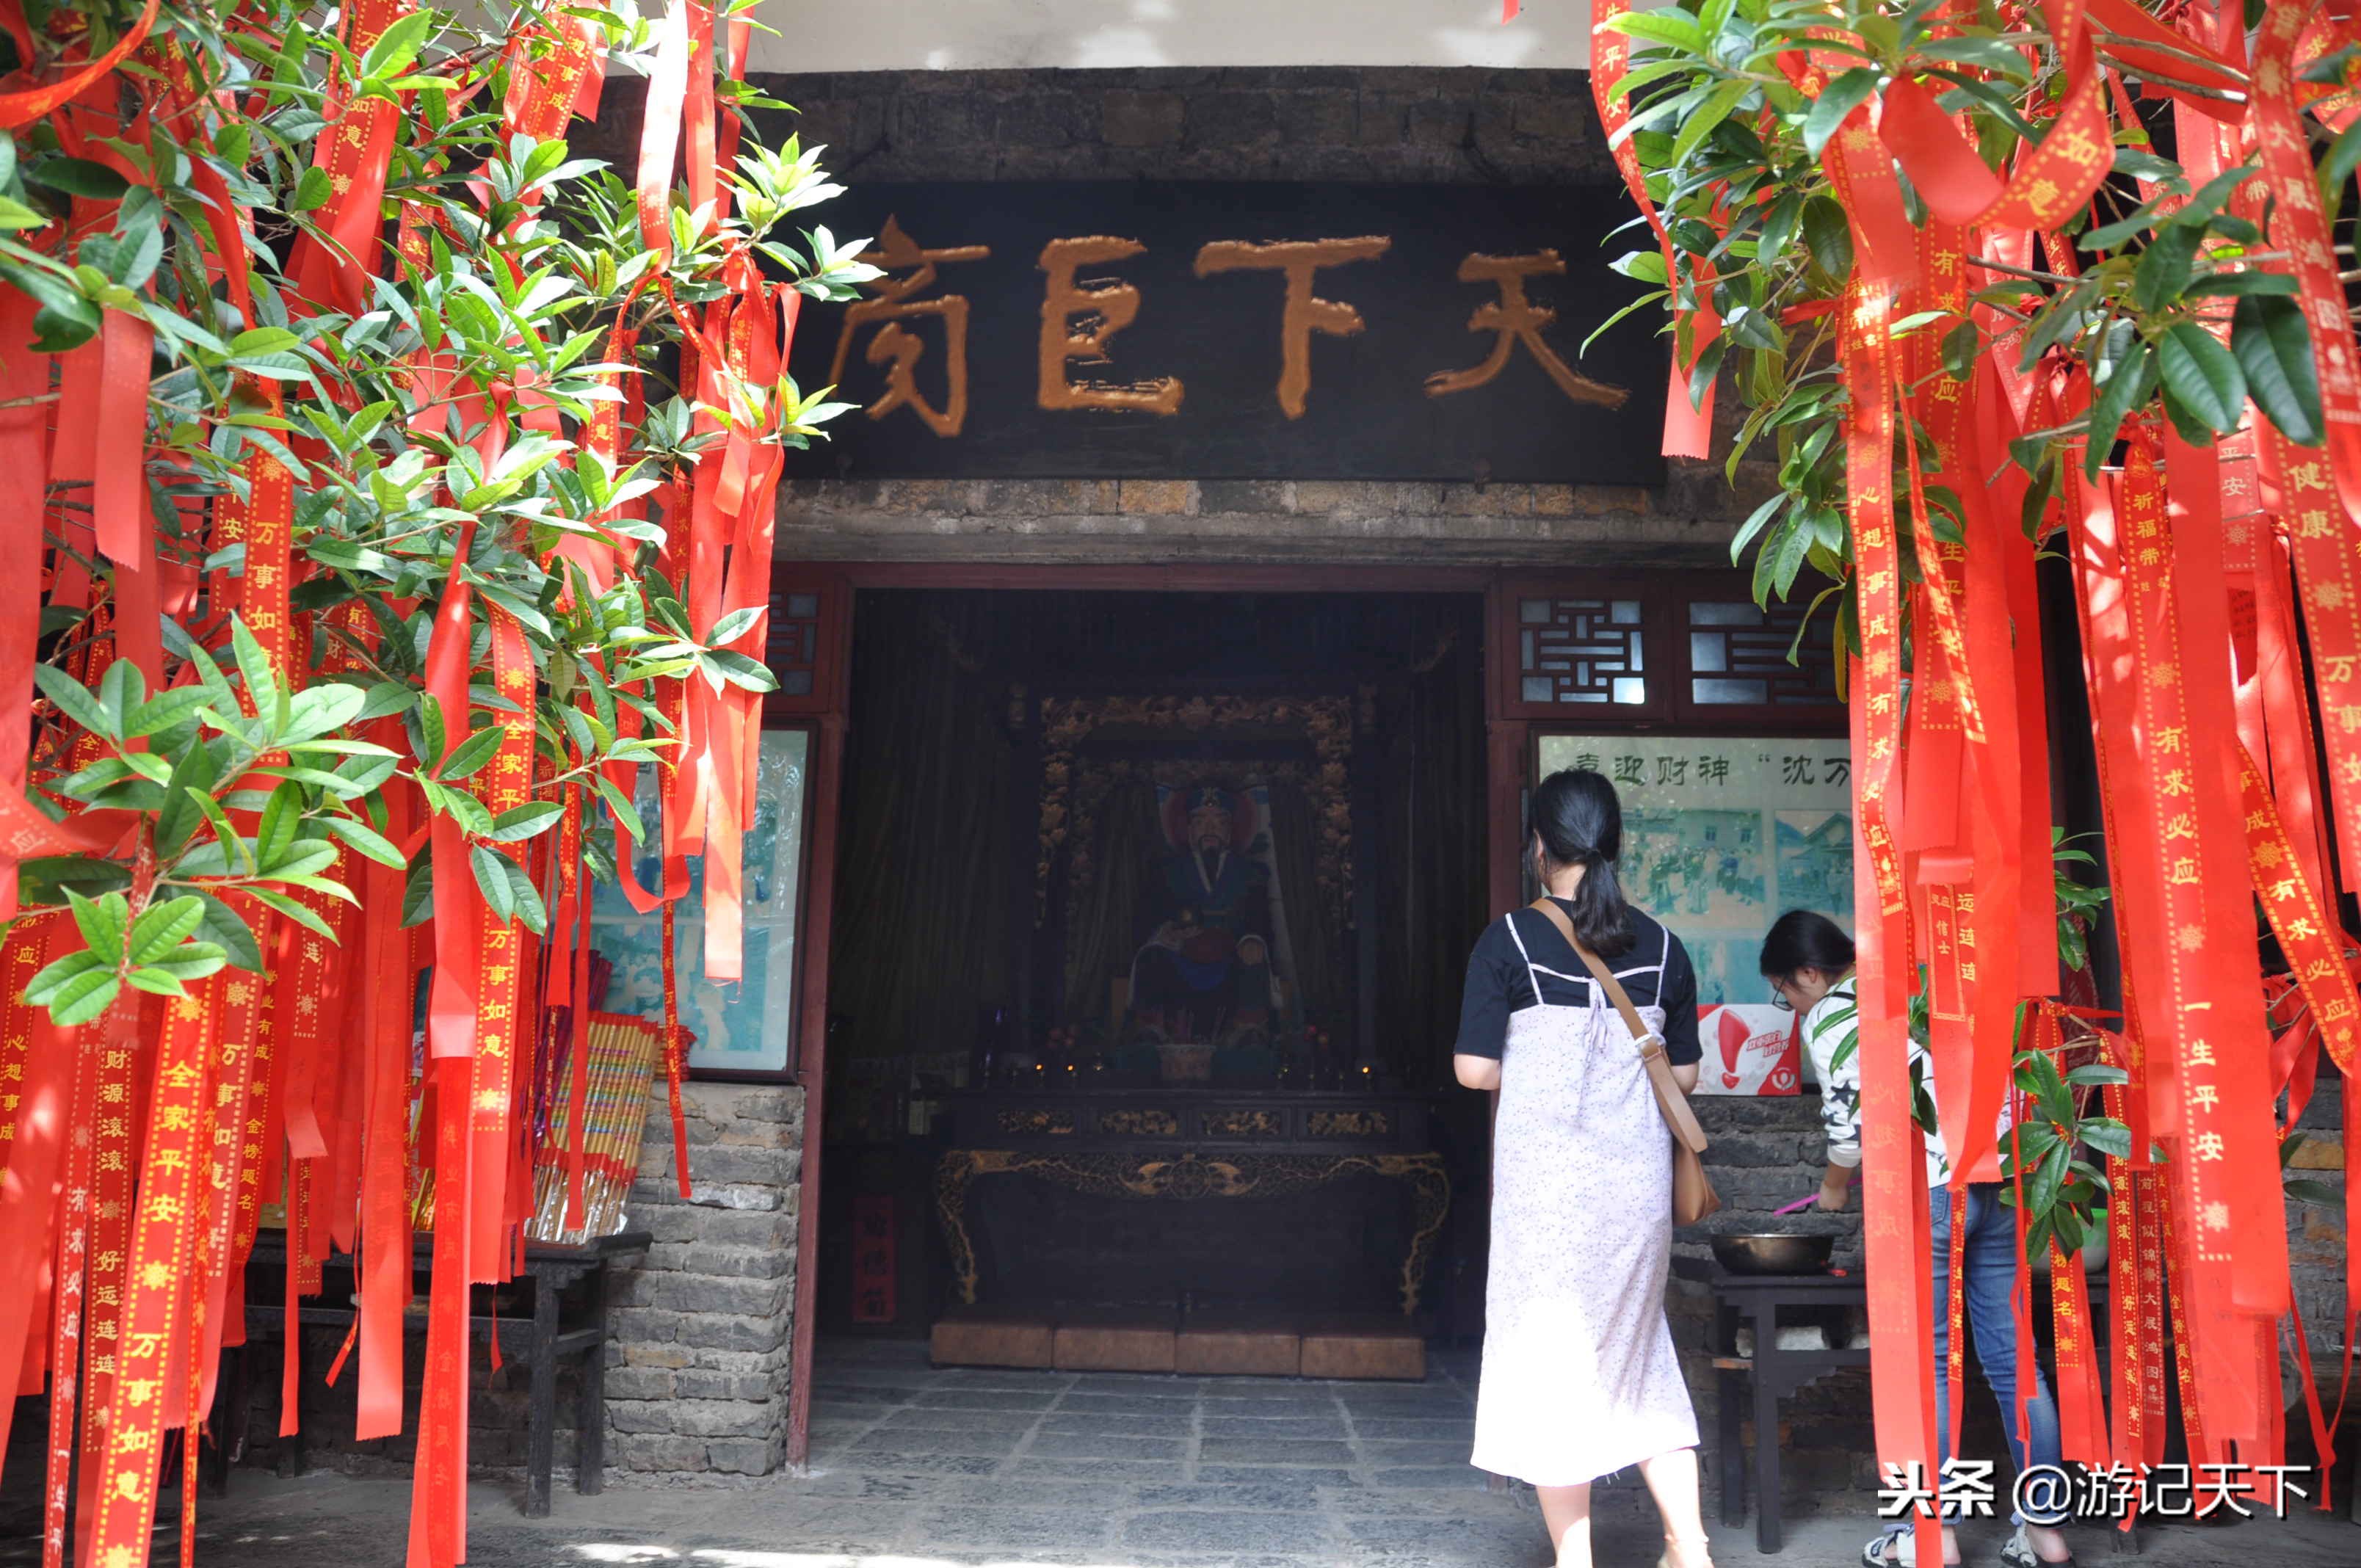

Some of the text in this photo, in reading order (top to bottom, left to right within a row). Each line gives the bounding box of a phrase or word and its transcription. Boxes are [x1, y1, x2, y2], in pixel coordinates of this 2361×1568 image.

[1934, 250, 1961, 404] 有求应
[1857, 486, 1889, 639] 心想事成
[484, 719, 526, 1057] 全家平 万事如意
[2133, 492, 2160, 566] 祈福带
[2156, 726, 2199, 885] 有求必应
[2184, 1001, 2223, 1161] 一生平安
[2268, 877, 2351, 1023] 有求必应
[95, 1050, 127, 1375] 财源滚滚 好运连连
[112, 1060, 196, 1502] 全家平安 万事如意
[238, 1118, 262, 1210] 金榜题名
